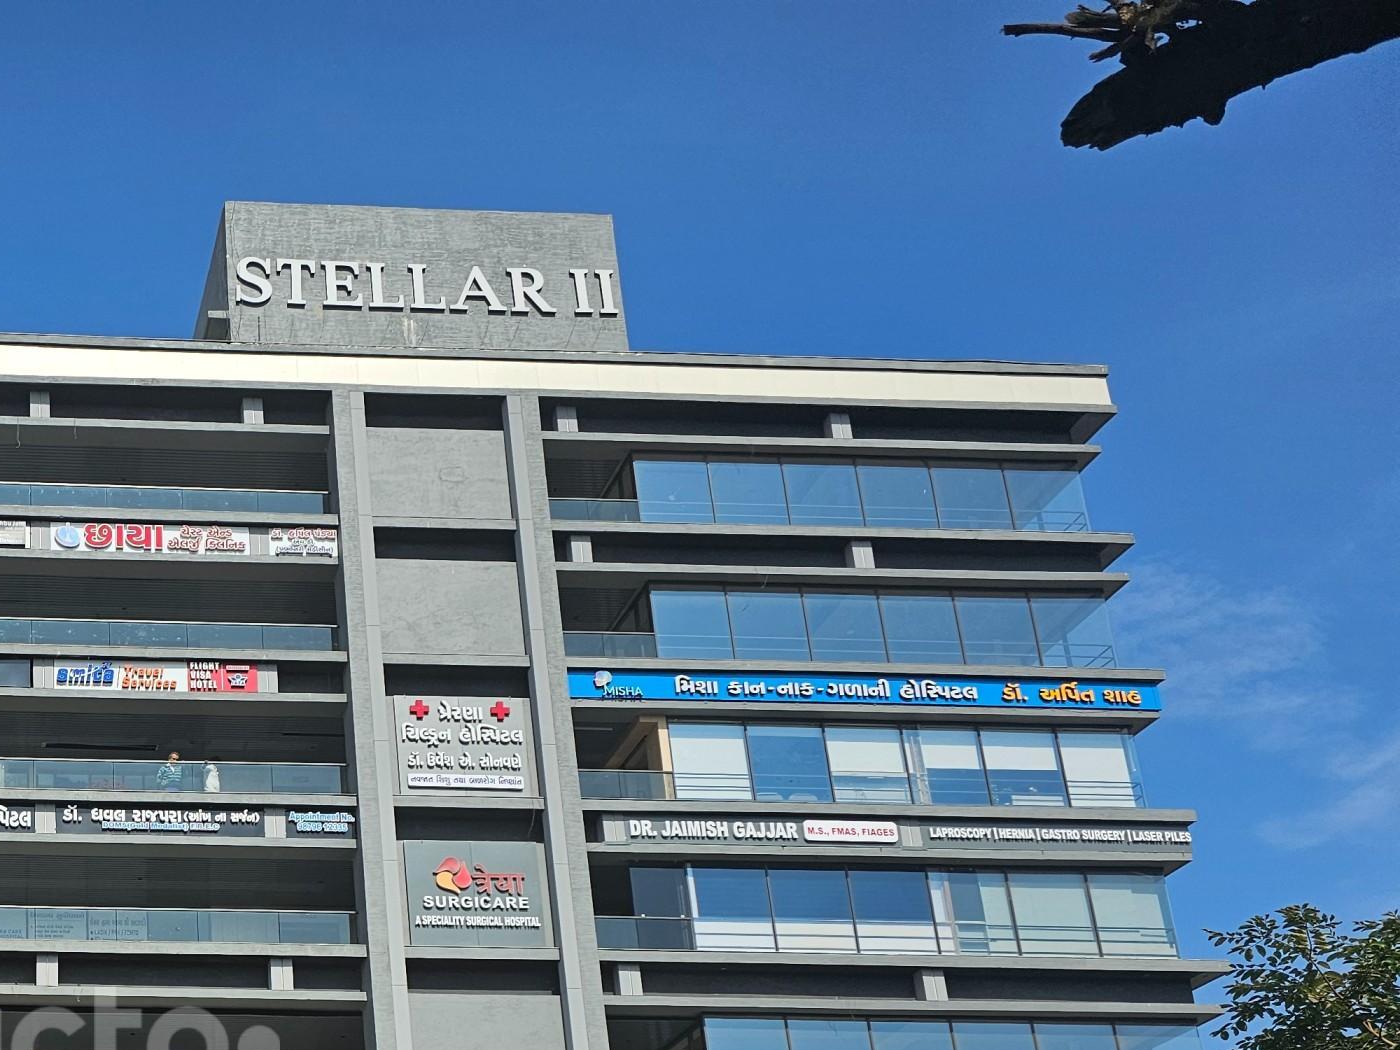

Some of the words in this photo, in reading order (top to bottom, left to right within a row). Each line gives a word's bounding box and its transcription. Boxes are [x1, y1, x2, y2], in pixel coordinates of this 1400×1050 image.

[235, 257, 557, 314] STELLAR
[569, 269, 619, 315] II
[84, 524, 163, 550] છાયા
[190, 662, 219, 671] FLIGHT
[190, 671, 212, 680] VISA
[190, 680, 218, 689] HOTEL
[603, 684, 643, 696] MISHA
[900, 679, 978, 700] હોસ્પિટલ
[1103, 689, 1142, 704] શાહ
[459, 723, 523, 744] હોસ્પિટલ
[288, 811, 340, 823] Appointment
[340, 812, 356, 822] No.
[629, 820, 658, 837] DR.
[661, 820, 729, 838] JAIMISH
[733, 821, 799, 839] GAJJAR
[930, 827, 992, 839] LAPROSCOPY
[999, 828, 1036, 840] HERNIA
[1041, 828, 1080, 840] GASTRO
[1083, 829, 1126, 841] SURGERY
[1132, 830, 1164, 842] LASER
[1165, 831, 1192, 843] PILES
[423, 895, 530, 909] SURGICARE
[415, 915, 422, 925] A
[422, 915, 465, 926] SPECIALITY
[467, 916, 504, 926] SURGICAL
[505, 917, 542, 927] HOSPITAL
